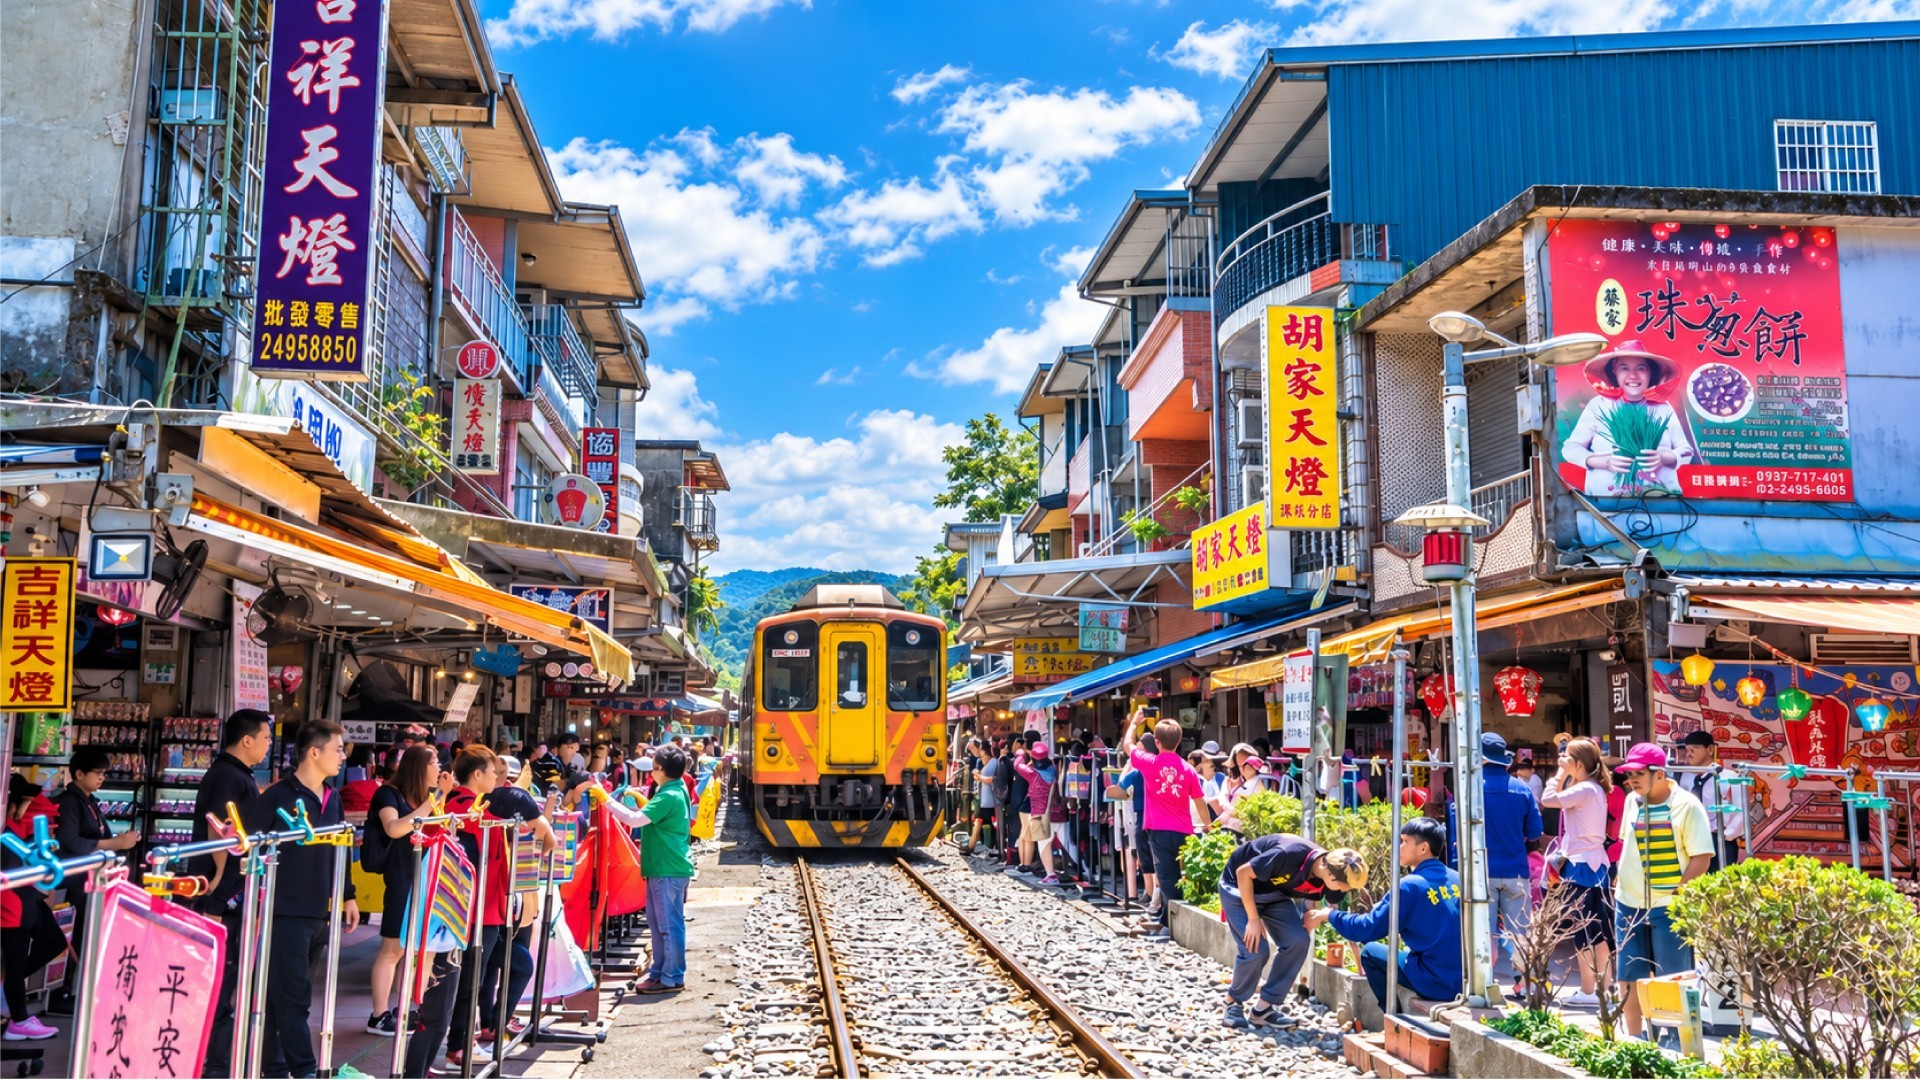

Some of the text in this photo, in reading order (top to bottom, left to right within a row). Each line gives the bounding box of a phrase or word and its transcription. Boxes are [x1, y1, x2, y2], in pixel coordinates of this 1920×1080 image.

[263, 299, 360, 330] 批發零售
[259, 332, 357, 364] 24958850
[1281, 313, 1329, 497] 胡家天燈
[1756, 470, 1845, 484] 0937-717-401
[152, 964, 188, 1078] 平安
